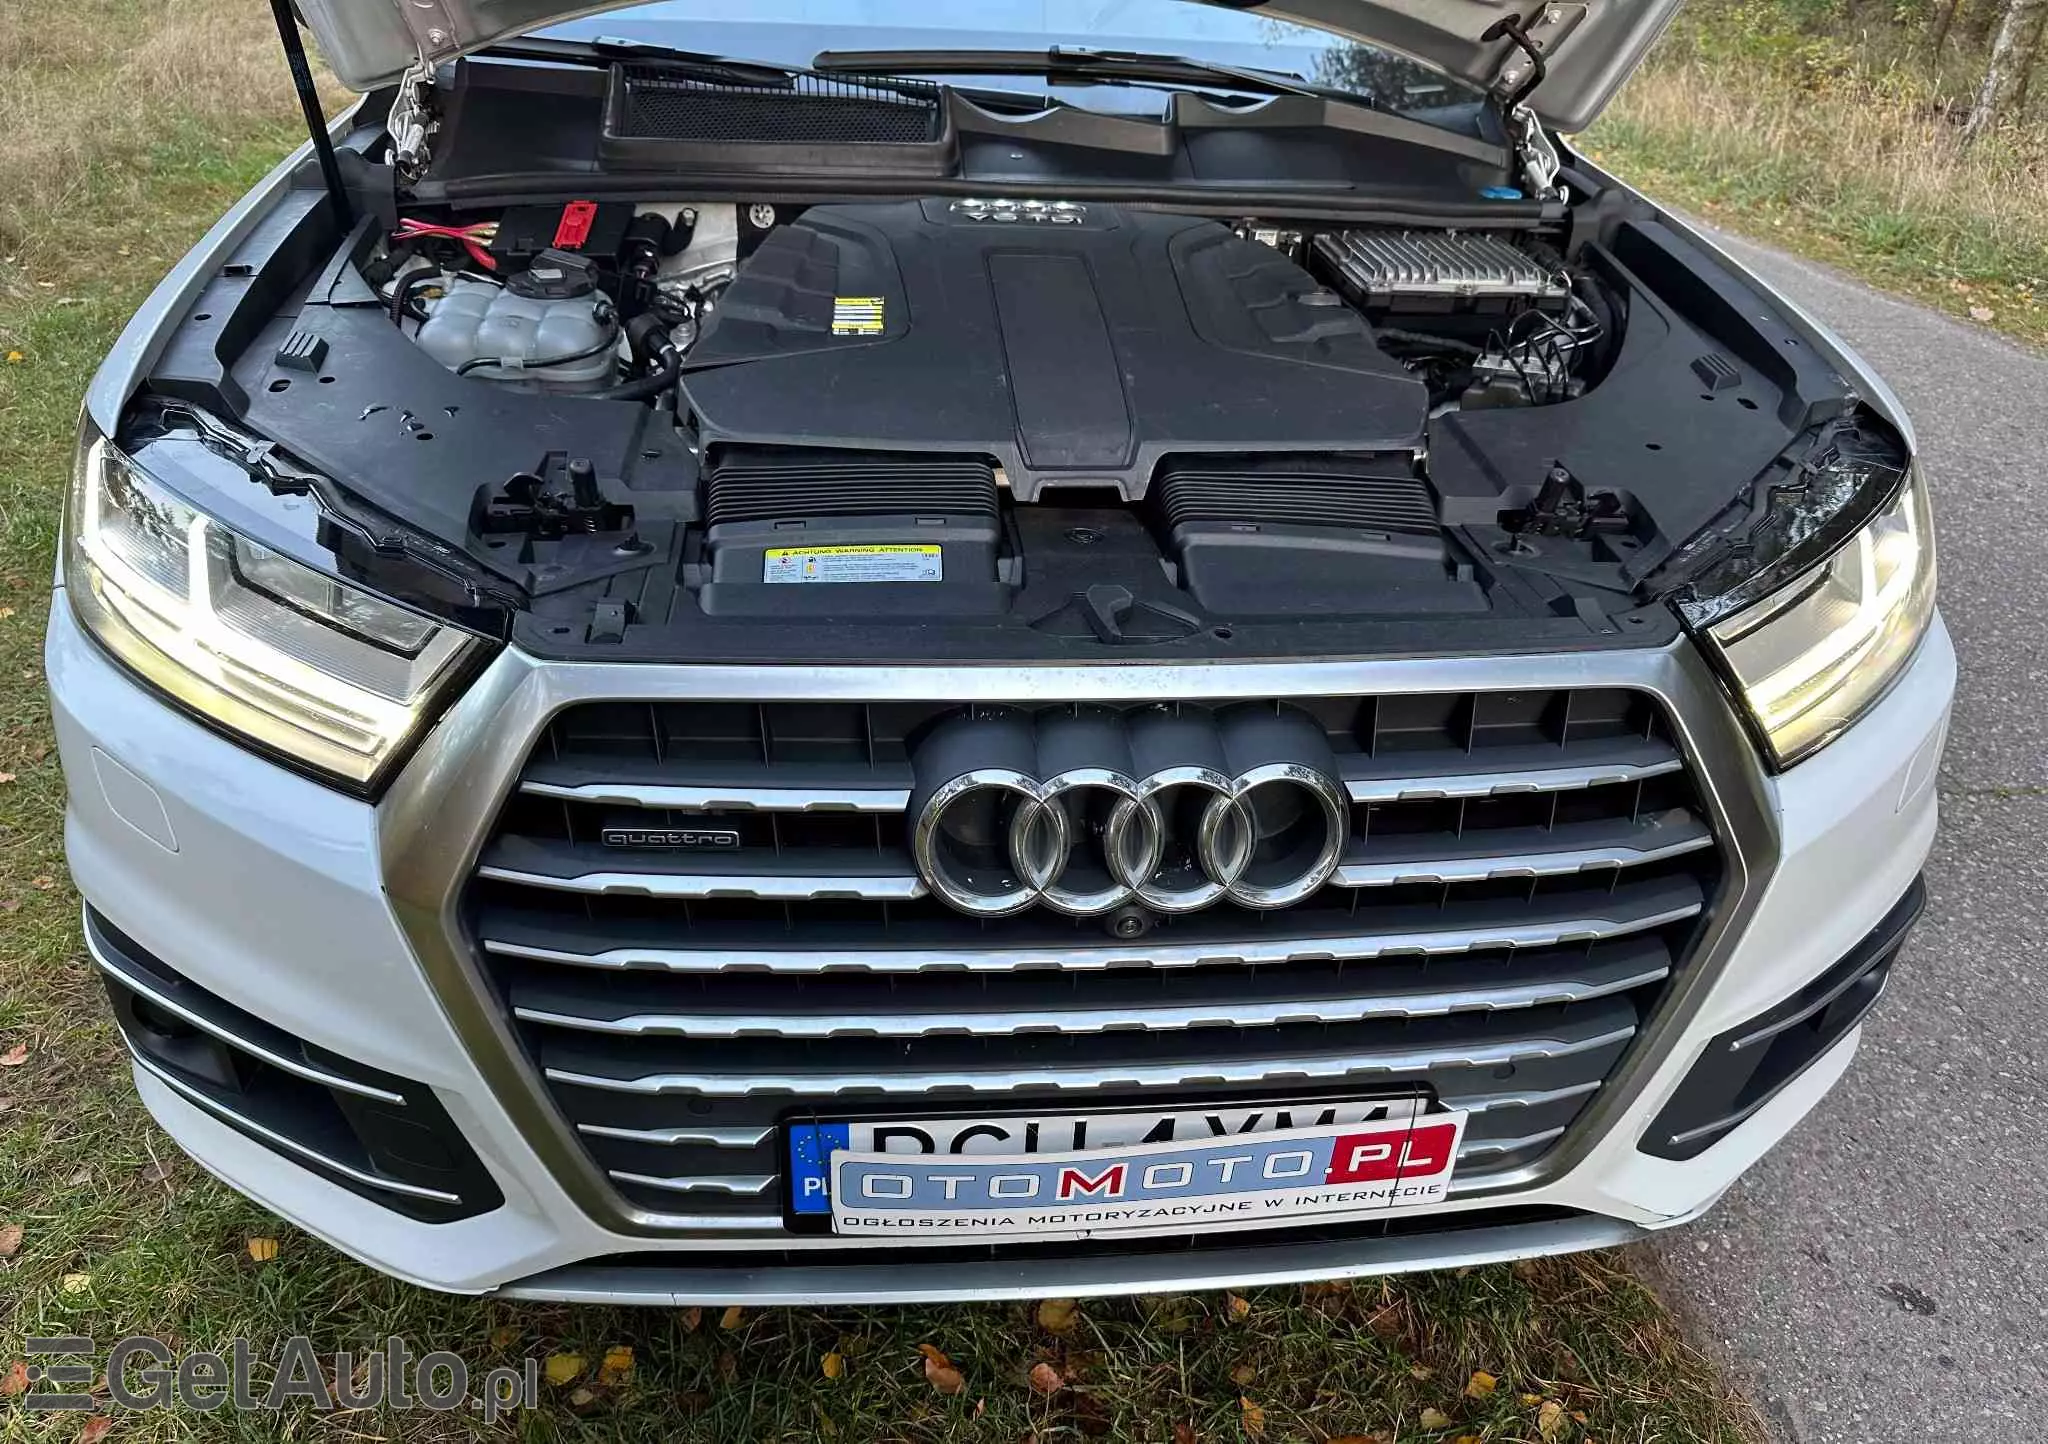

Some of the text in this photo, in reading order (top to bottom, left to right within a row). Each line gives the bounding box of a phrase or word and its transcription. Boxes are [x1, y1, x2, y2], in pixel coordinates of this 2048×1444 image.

[608, 833, 732, 845] quattro
[861, 1140, 1432, 1200] OTOMOTO.PL
[843, 1184, 1442, 1227] OGŁOSZENIA MOTORYZACYJNE W INTERNECIE
